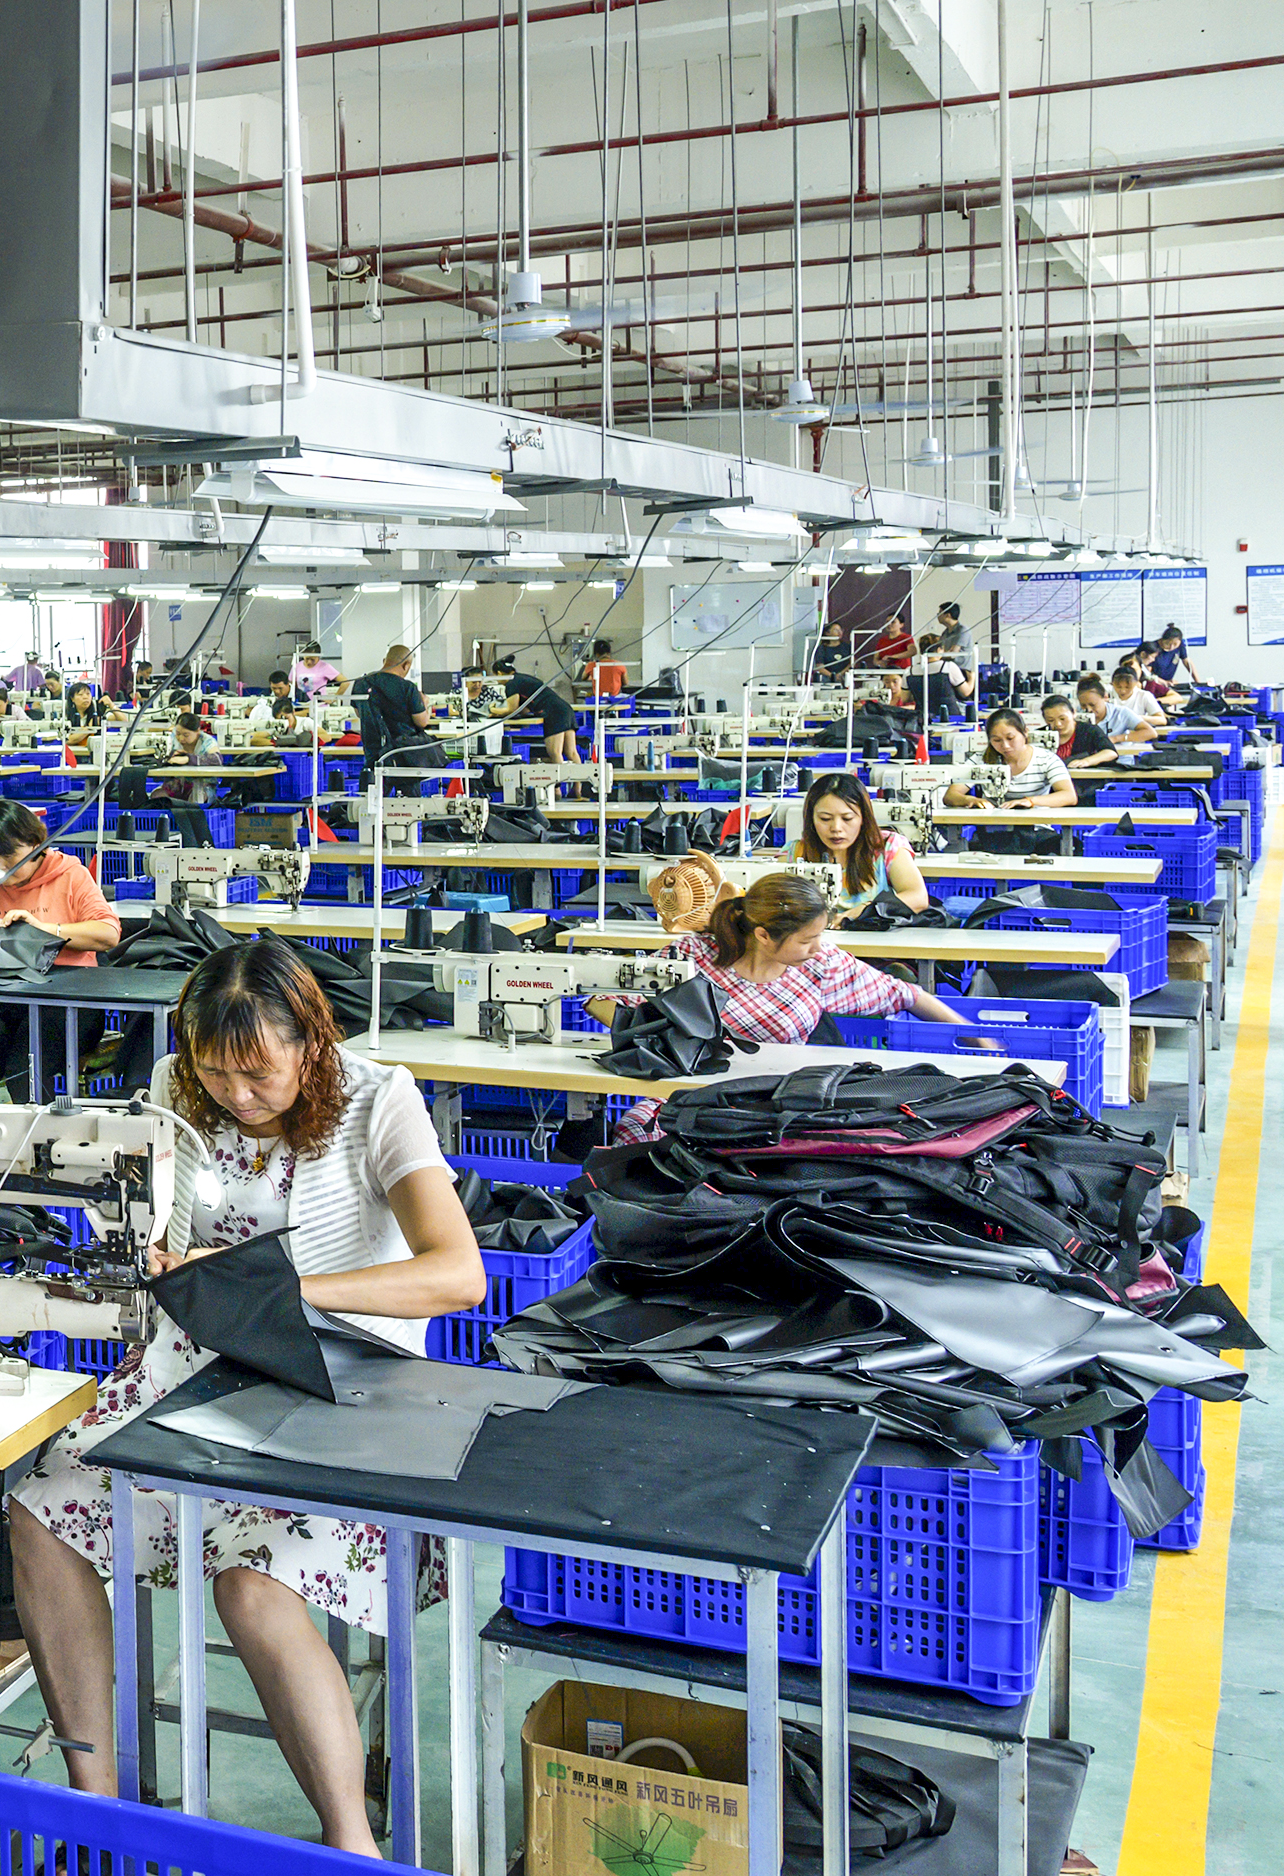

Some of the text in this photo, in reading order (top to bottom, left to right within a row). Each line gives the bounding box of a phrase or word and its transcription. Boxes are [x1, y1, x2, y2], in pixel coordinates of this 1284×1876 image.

[506, 979, 554, 990] GOLDEN WHEEL
[572, 1770, 628, 1792] 新风通风
[636, 1780, 739, 1817] 新风五叶吊扇
